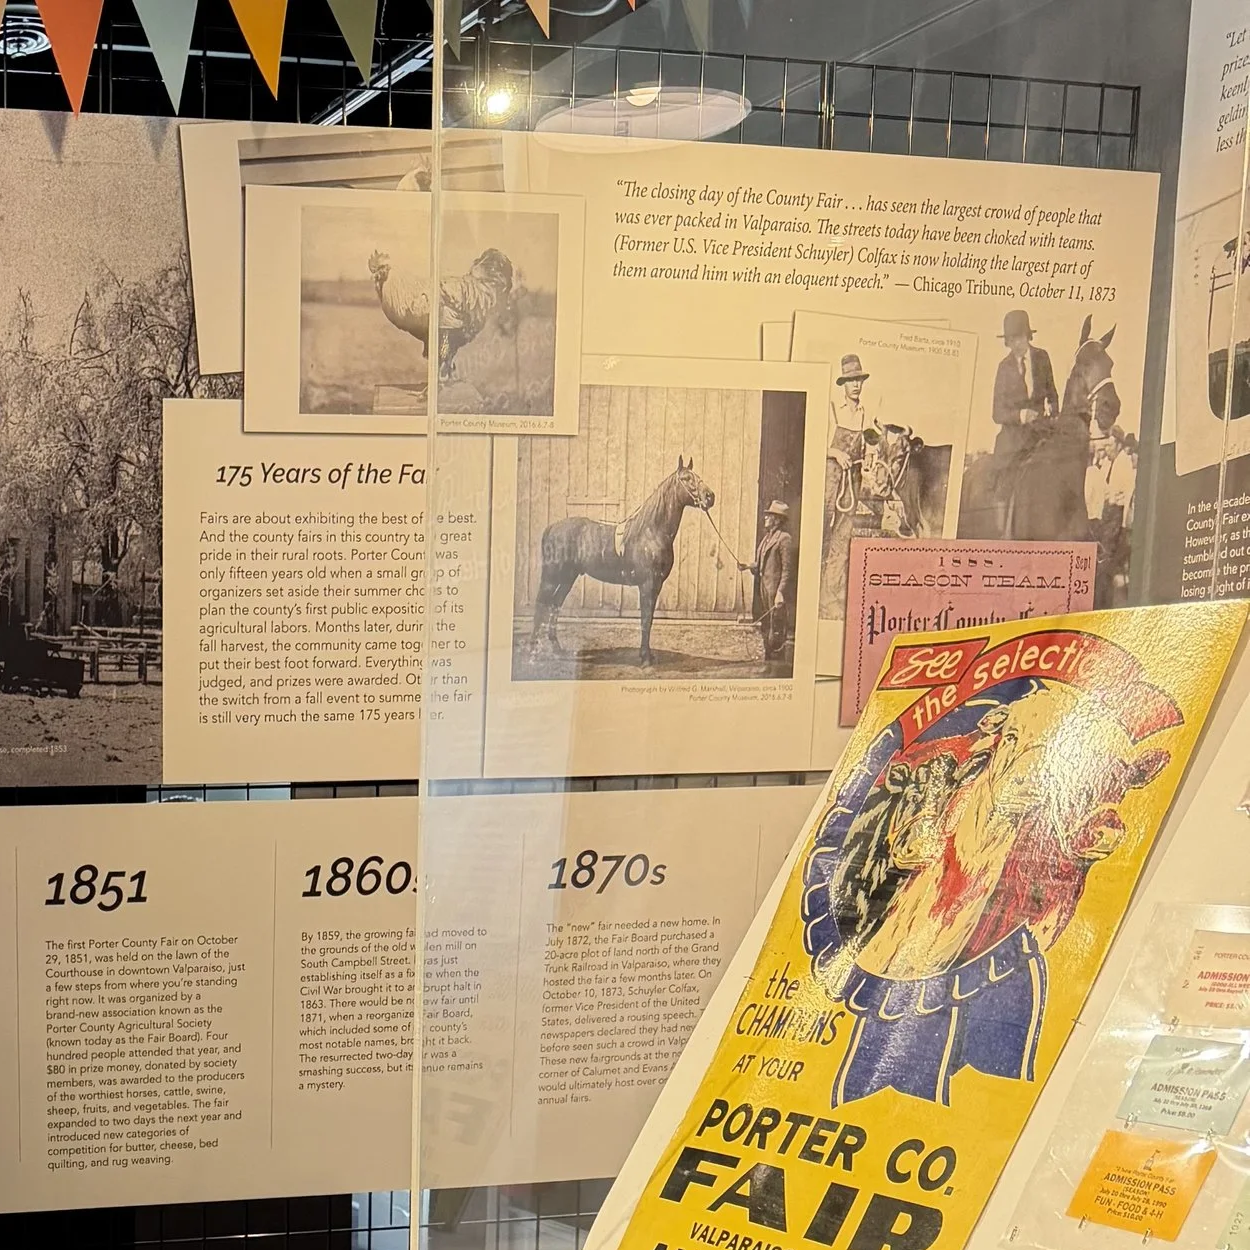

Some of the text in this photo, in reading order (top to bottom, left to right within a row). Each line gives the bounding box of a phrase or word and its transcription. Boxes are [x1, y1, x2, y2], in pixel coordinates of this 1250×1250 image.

[651, 182, 697, 206] closing
[699, 185, 724, 207] day
[727, 187, 741, 208] of
[743, 188, 763, 205] the
[766, 189, 814, 212] County
[866, 195, 888, 212] has
[890, 202, 917, 216] seen
[920, 198, 940, 216] the
[942, 200, 982, 222] largest
[984, 204, 1022, 221] crowd
[1024, 206, 1038, 226] of
[1036, 208, 1076, 228] people
[1078, 209, 1102, 225] that
[616, 211, 1094, 252] was ever packed in Valparaiso. The streets today have been choked with teams.
[614, 234, 1094, 280] (Former U.S. Vice President Schuyler) Colfax is now holding the largest part of
[614, 260, 647, 278] them
[650, 264, 700, 280] around
[702, 264, 728, 281] him
[733, 266, 761, 283] with
[764, 272, 781, 284] an
[785, 268, 840, 290] eloquent
[914, 276, 962, 298] Chicago
[966, 279, 1015, 298] Tribune,
[1020, 282, 1066, 298] October
[1068, 286, 1084, 302] 11,
[1089, 286, 1116, 302] 1873
[216, 466, 253, 487] 175
[261, 462, 322, 484] Years
[328, 463, 354, 490] of
[357, 463, 392, 484] the
[1188, 501, 1211, 515] In the
[200, 512, 477, 528] Fairs are about exhibiting the best of best.
[1223, 512, 1240, 525] Fair
[200, 530, 472, 546] And the county fairs in this country great
[868, 573, 1065, 589] SEASON TEAM.
[1073, 580, 1089, 594] 25
[1181, 585, 1205, 598] losing
[890, 648, 963, 685] See
[912, 684, 957, 730] the
[548, 850, 667, 894] 1870s
[45, 864, 148, 912] 1851
[546, 924, 564, 933] The
[567, 922, 595, 932] “new”
[598, 921, 612, 931] fair
[614, 918, 650, 930] needed
[652, 921, 658, 931] a
[682, 917, 710, 928] home.
[712, 916, 720, 926] In
[46, 940, 64, 950] The
[67, 940, 86, 950] first
[89, 939, 119, 949] Porter
[122, 938, 158, 950] County
[161, 937, 179, 947] Fair
[197, 935, 238, 947] October
[301, 954, 411, 970] South Campbell Street.
[764, 962, 800, 1000] the
[732, 1054, 805, 1081] AT YOUR
[307, 1078, 345, 1092] mystery.
[1151, 1082, 1227, 1101] ADMISSION PASS
[538, 1092, 591, 1105] annual fairs.
[696, 1099, 957, 1197] PORTER CO.
[48, 1155, 173, 1172] quilting, and rug weaving.
[1104, 1173, 1152, 1190] ADMISSION
[1153, 1183, 1177, 1195] PASS
[1094, 1195, 1113, 1206] FUN
[1116, 1200, 1142, 1214] FOOD
